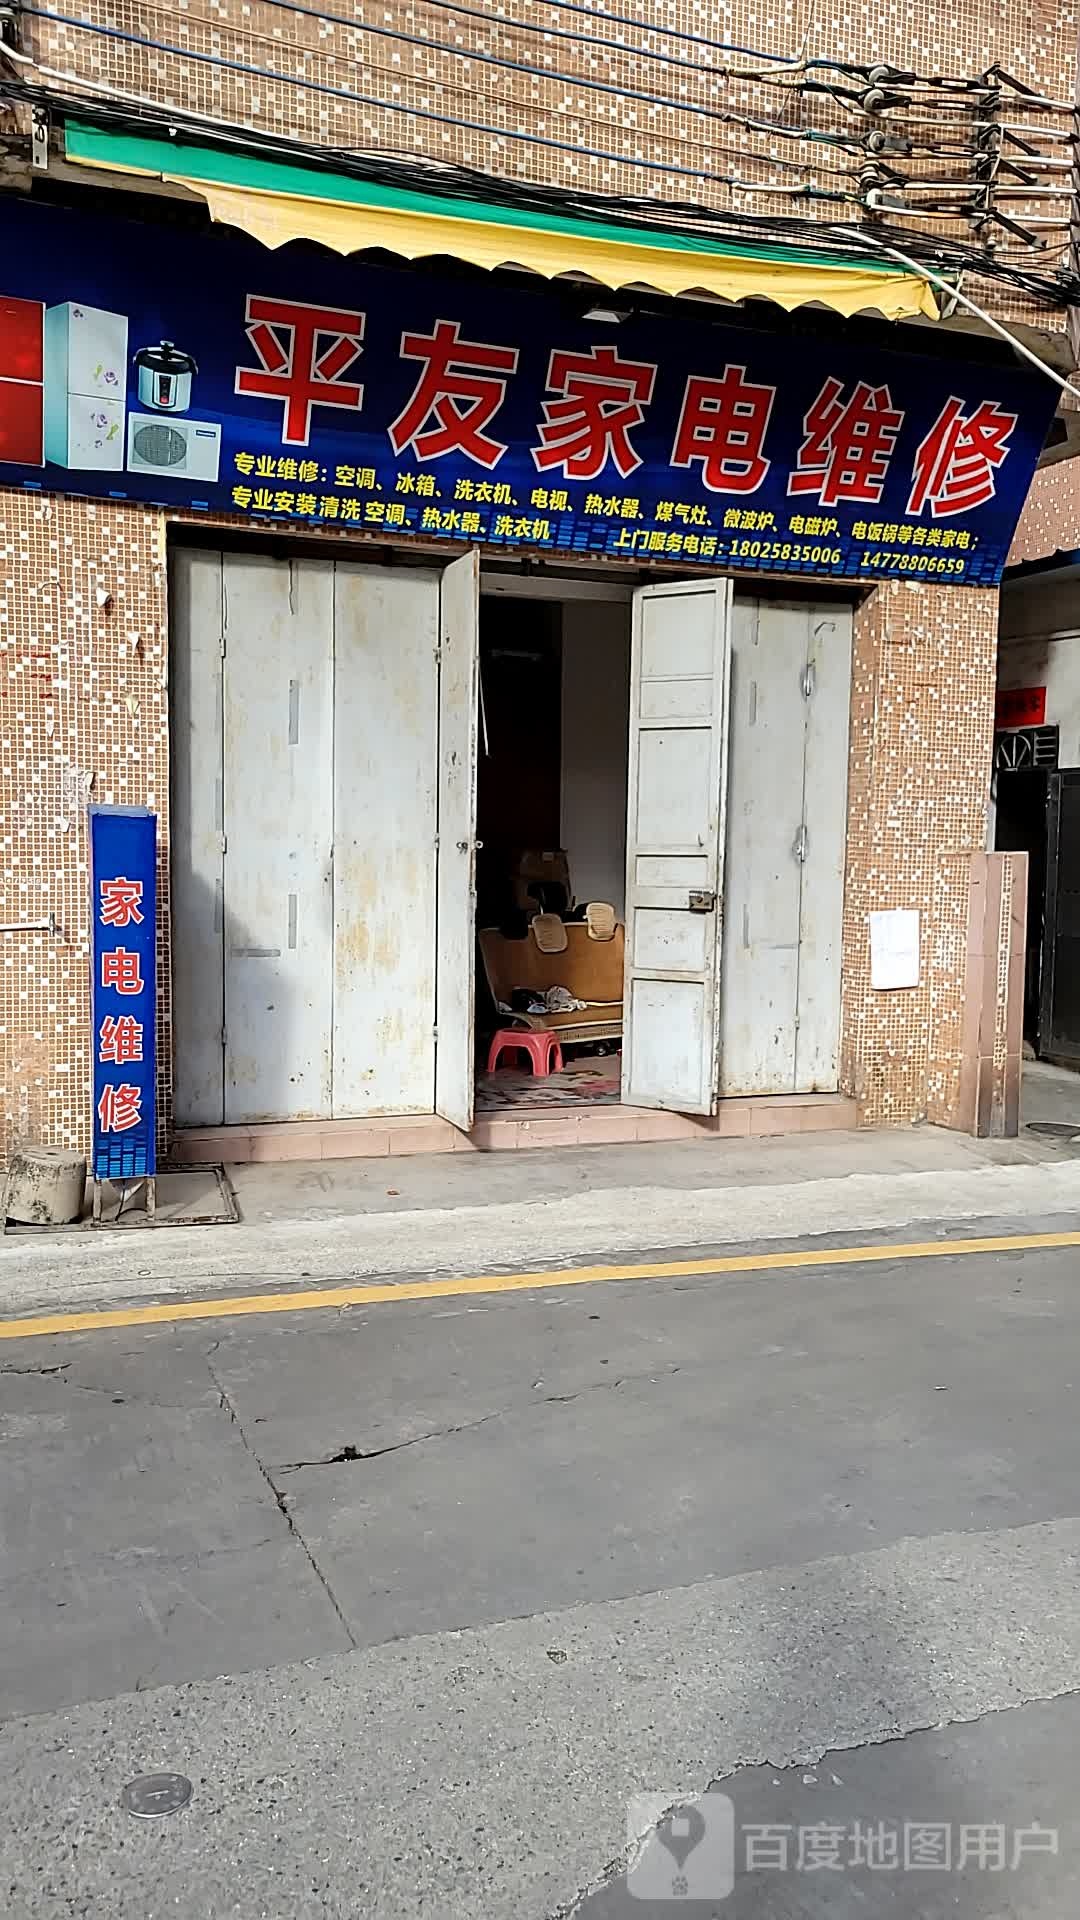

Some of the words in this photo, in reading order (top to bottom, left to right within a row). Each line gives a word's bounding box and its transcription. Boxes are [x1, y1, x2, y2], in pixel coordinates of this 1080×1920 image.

[233, 293, 1019, 518] 平友家电维修
[860, 551, 965, 574] 14778806659
[98, 876, 144, 1132] 家电维修
